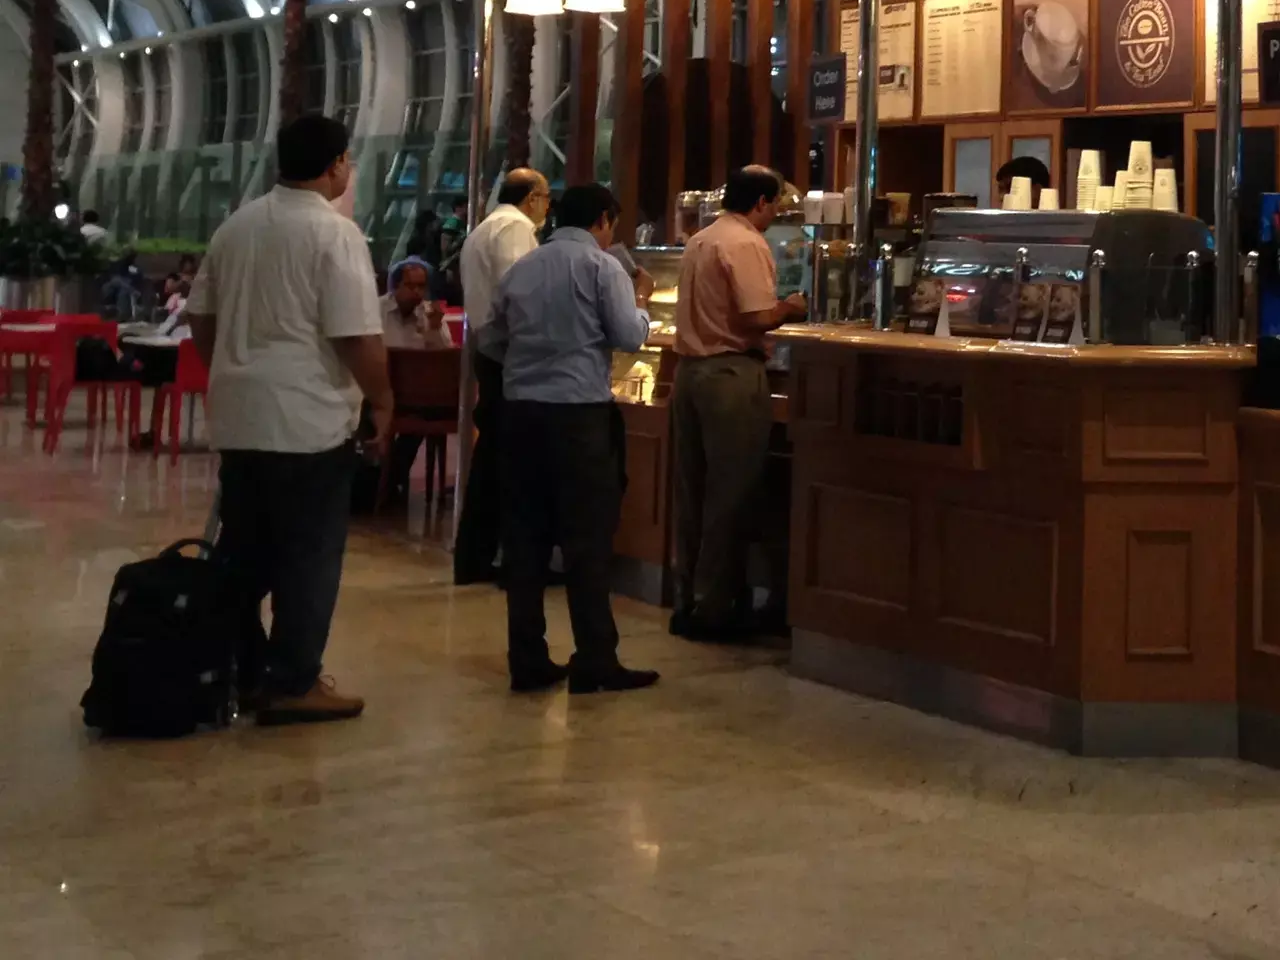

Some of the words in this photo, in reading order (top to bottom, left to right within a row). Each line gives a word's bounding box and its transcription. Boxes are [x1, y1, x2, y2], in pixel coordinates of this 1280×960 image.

[1154, 0, 1168, 35] Bean
[813, 70, 839, 87] Order
[815, 95, 836, 110] Here
